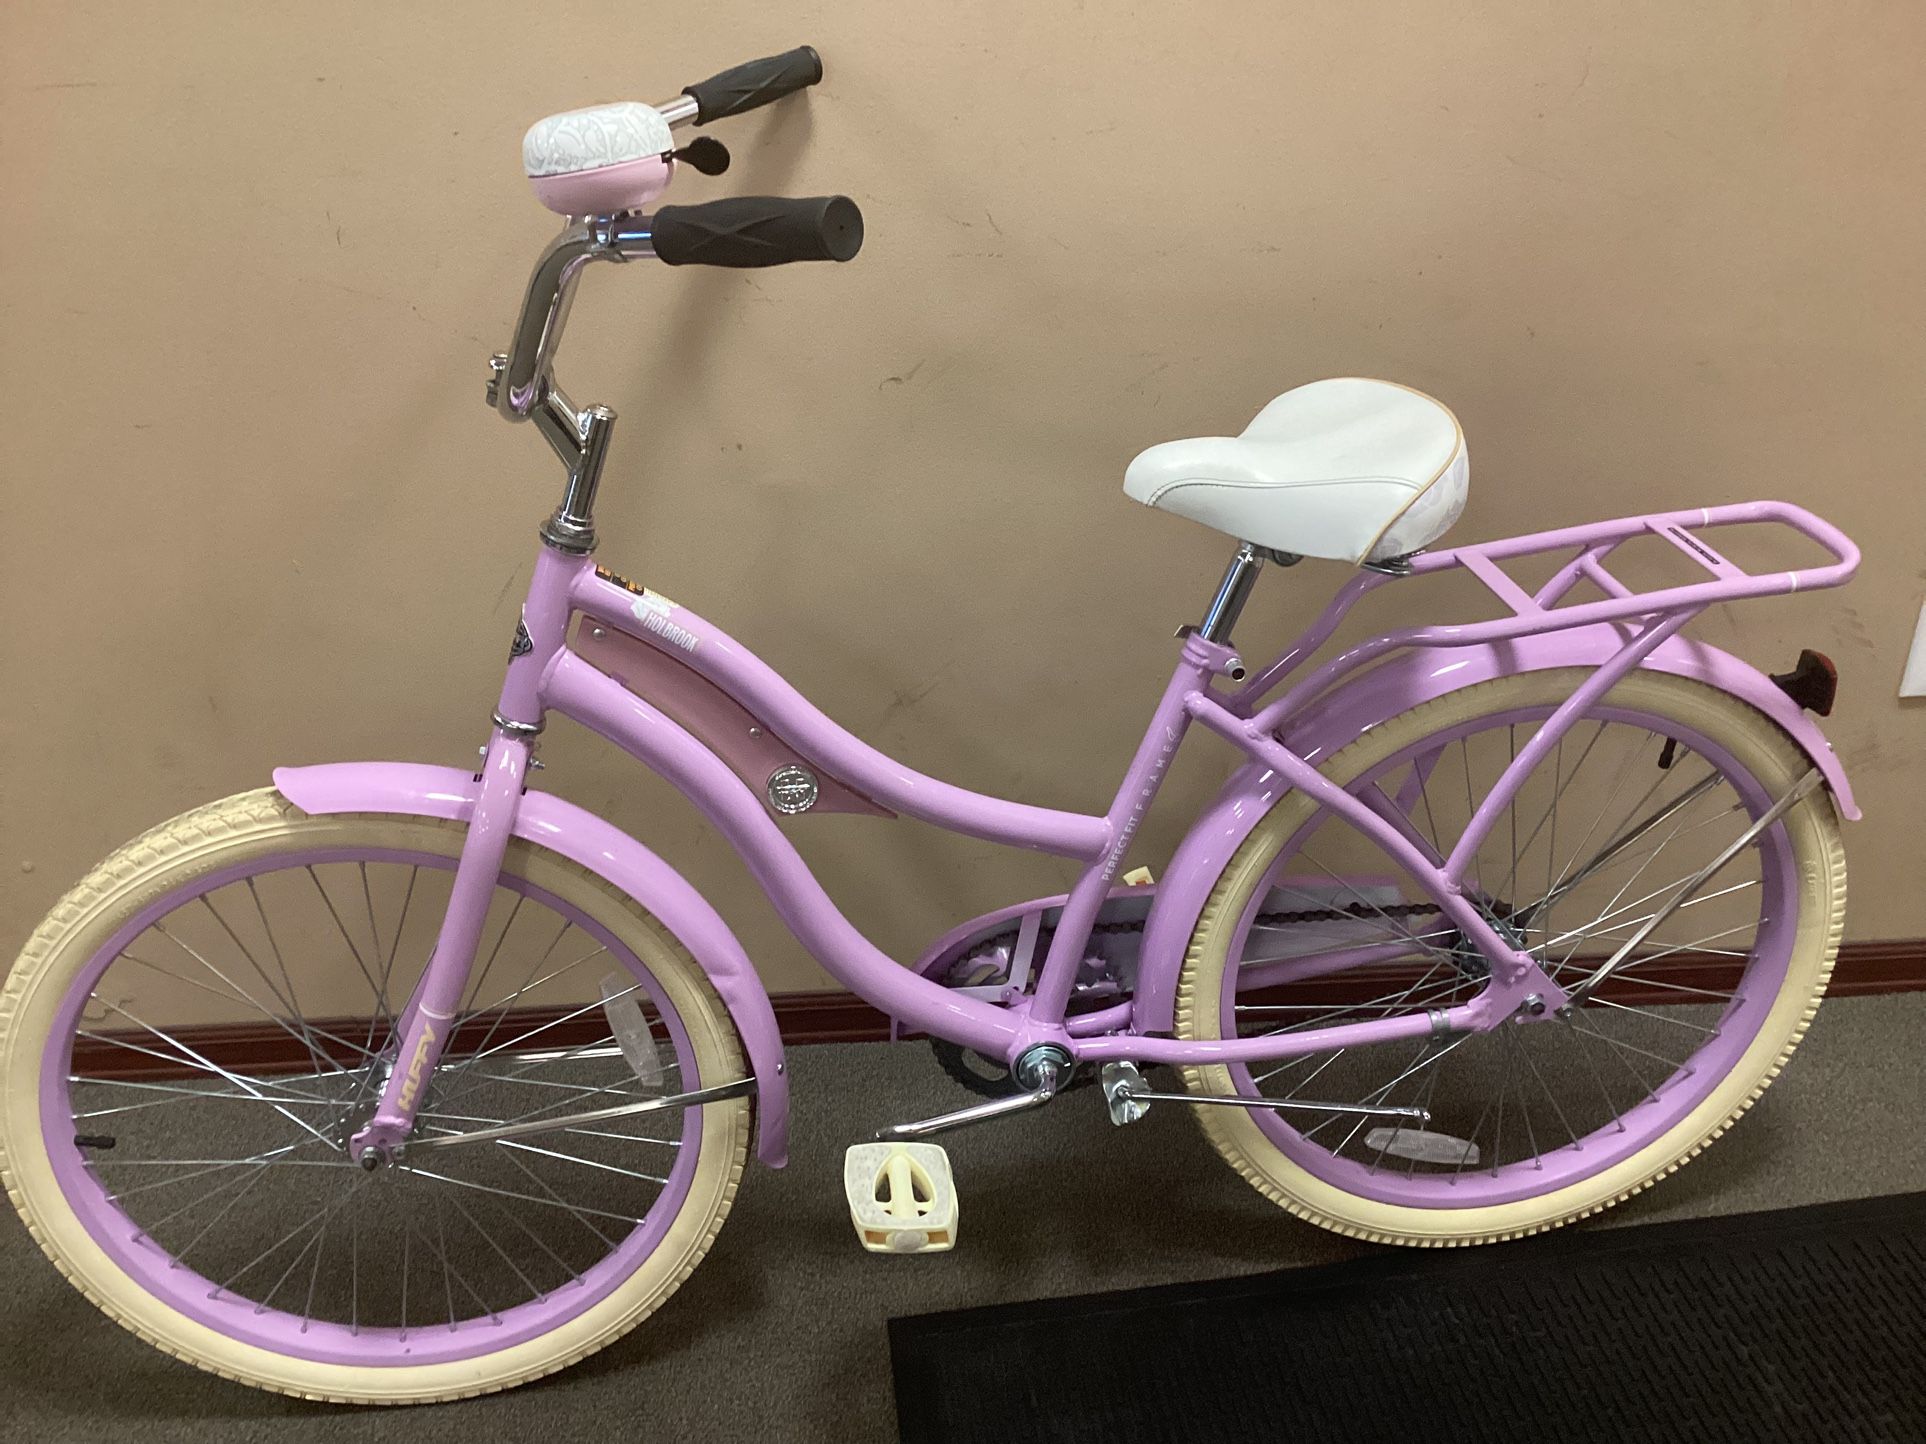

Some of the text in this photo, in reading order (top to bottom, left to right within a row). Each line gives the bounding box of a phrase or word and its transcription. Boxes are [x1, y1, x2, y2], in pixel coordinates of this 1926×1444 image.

[644, 612, 699, 652] HOLBROOK
[1101, 744, 1173, 881] PERFECT FIT FRAME
[397, 1021, 436, 1112] HUFFY
